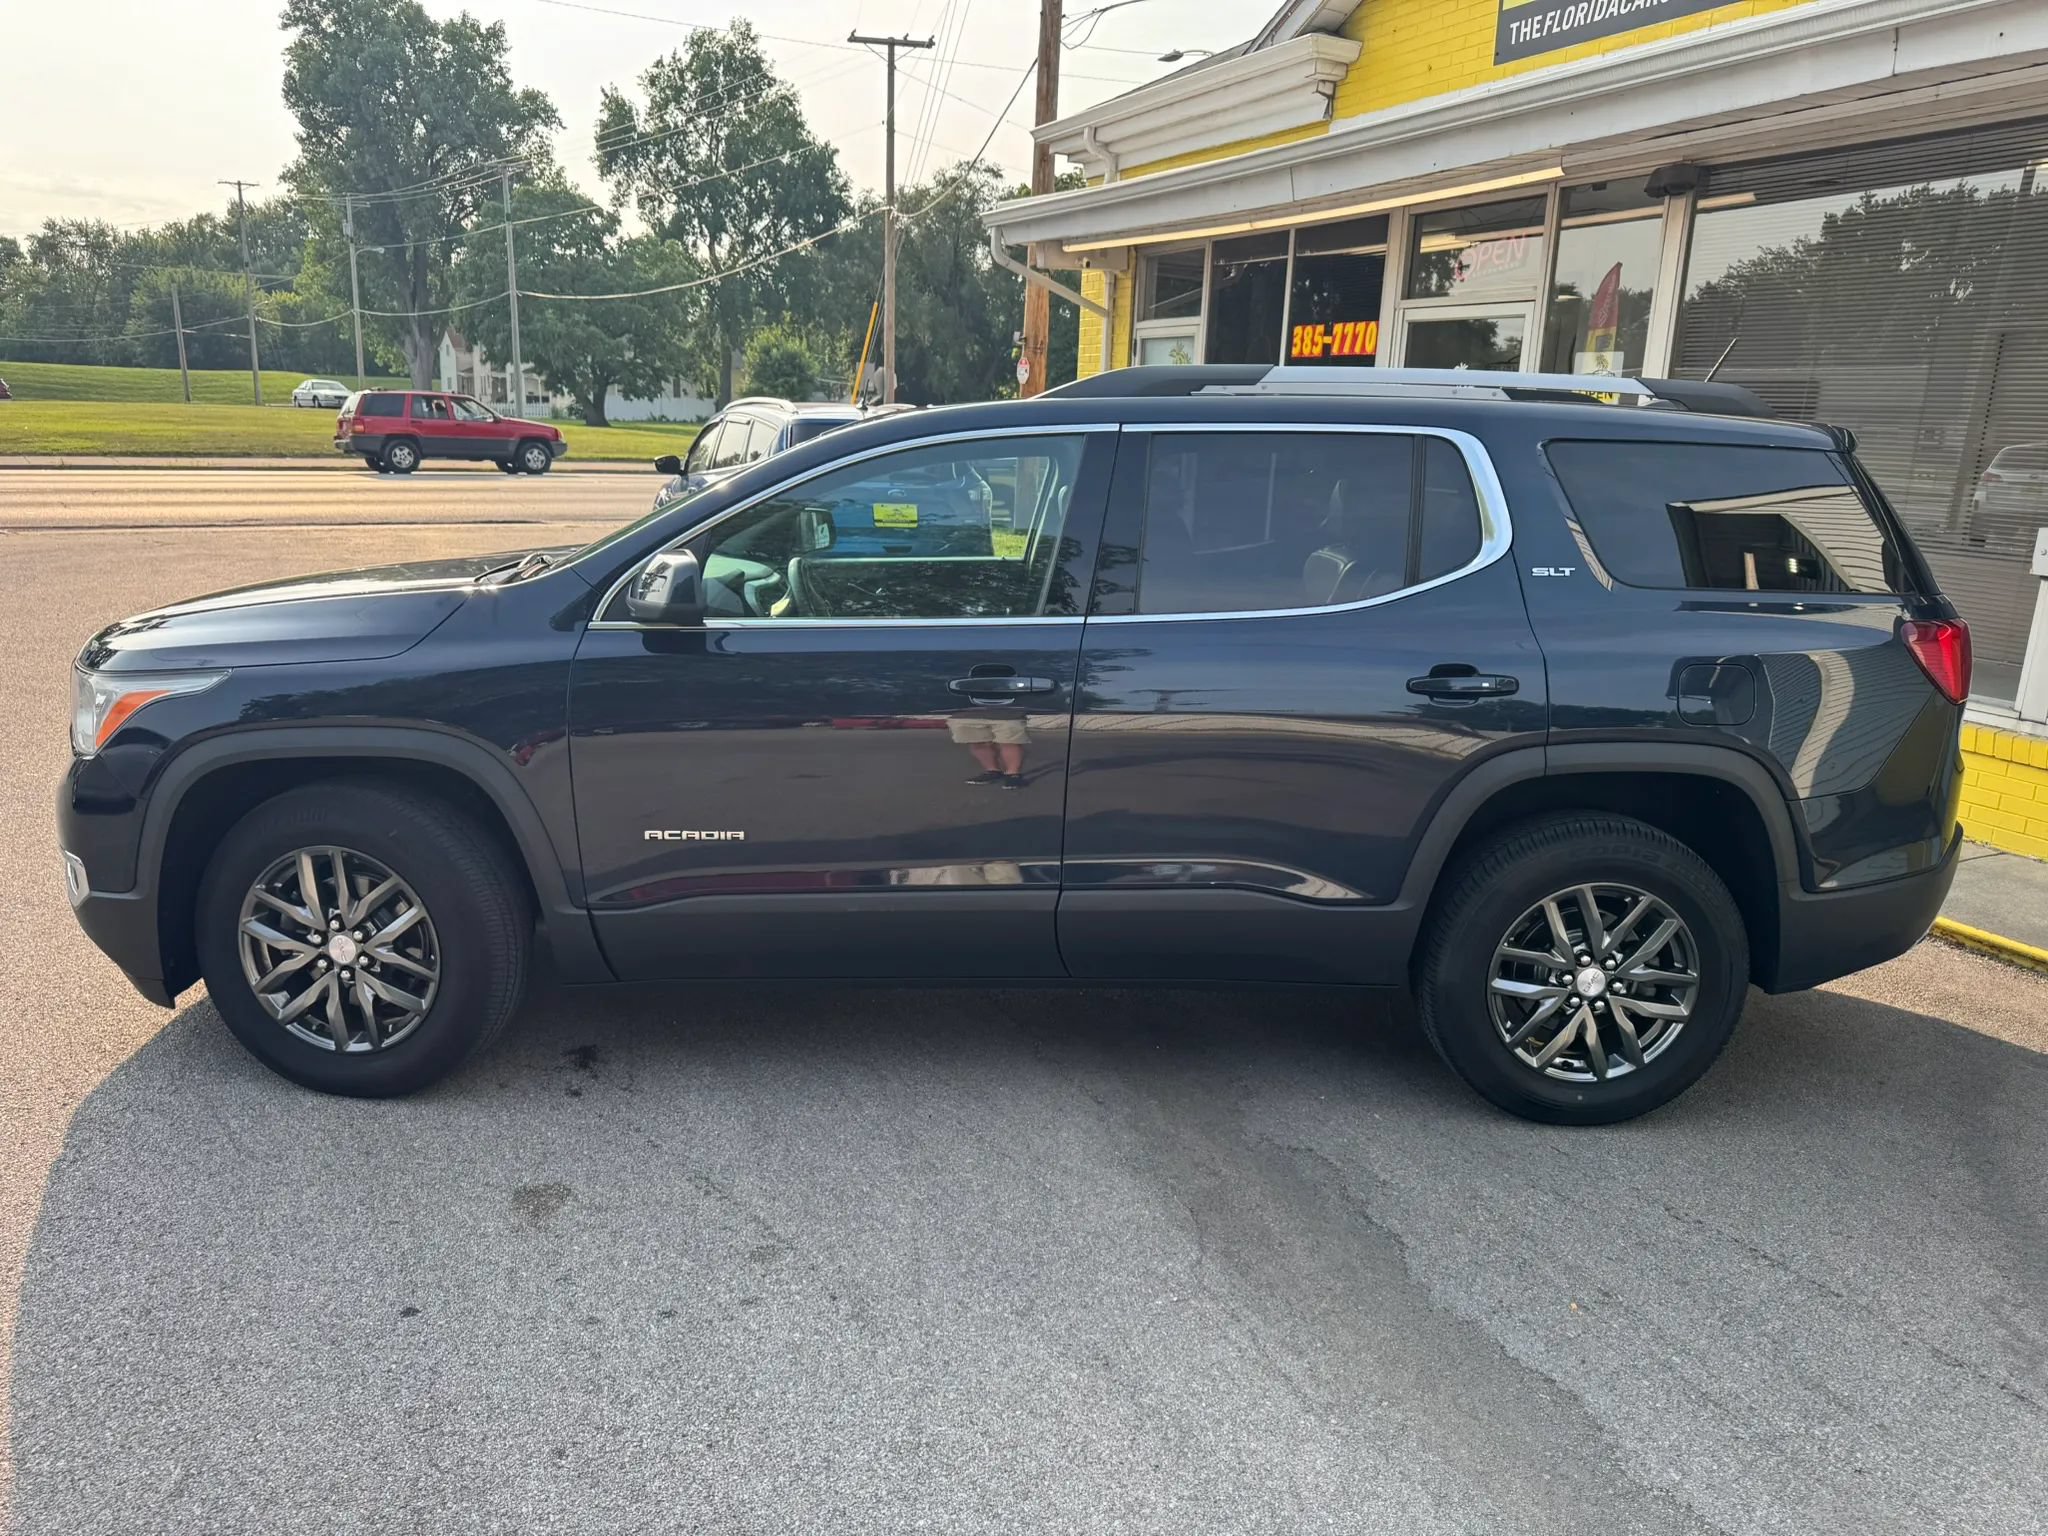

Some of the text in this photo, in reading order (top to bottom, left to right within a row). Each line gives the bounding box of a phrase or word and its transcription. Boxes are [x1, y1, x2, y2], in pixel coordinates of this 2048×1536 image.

[1510, 0, 1668, 44] THEFLORIDAC
[1456, 239, 1525, 283] OPEN
[1292, 321, 1377, 357] 385-7770
[1532, 567, 1576, 577] SLT
[644, 830, 745, 841] ACADIA
